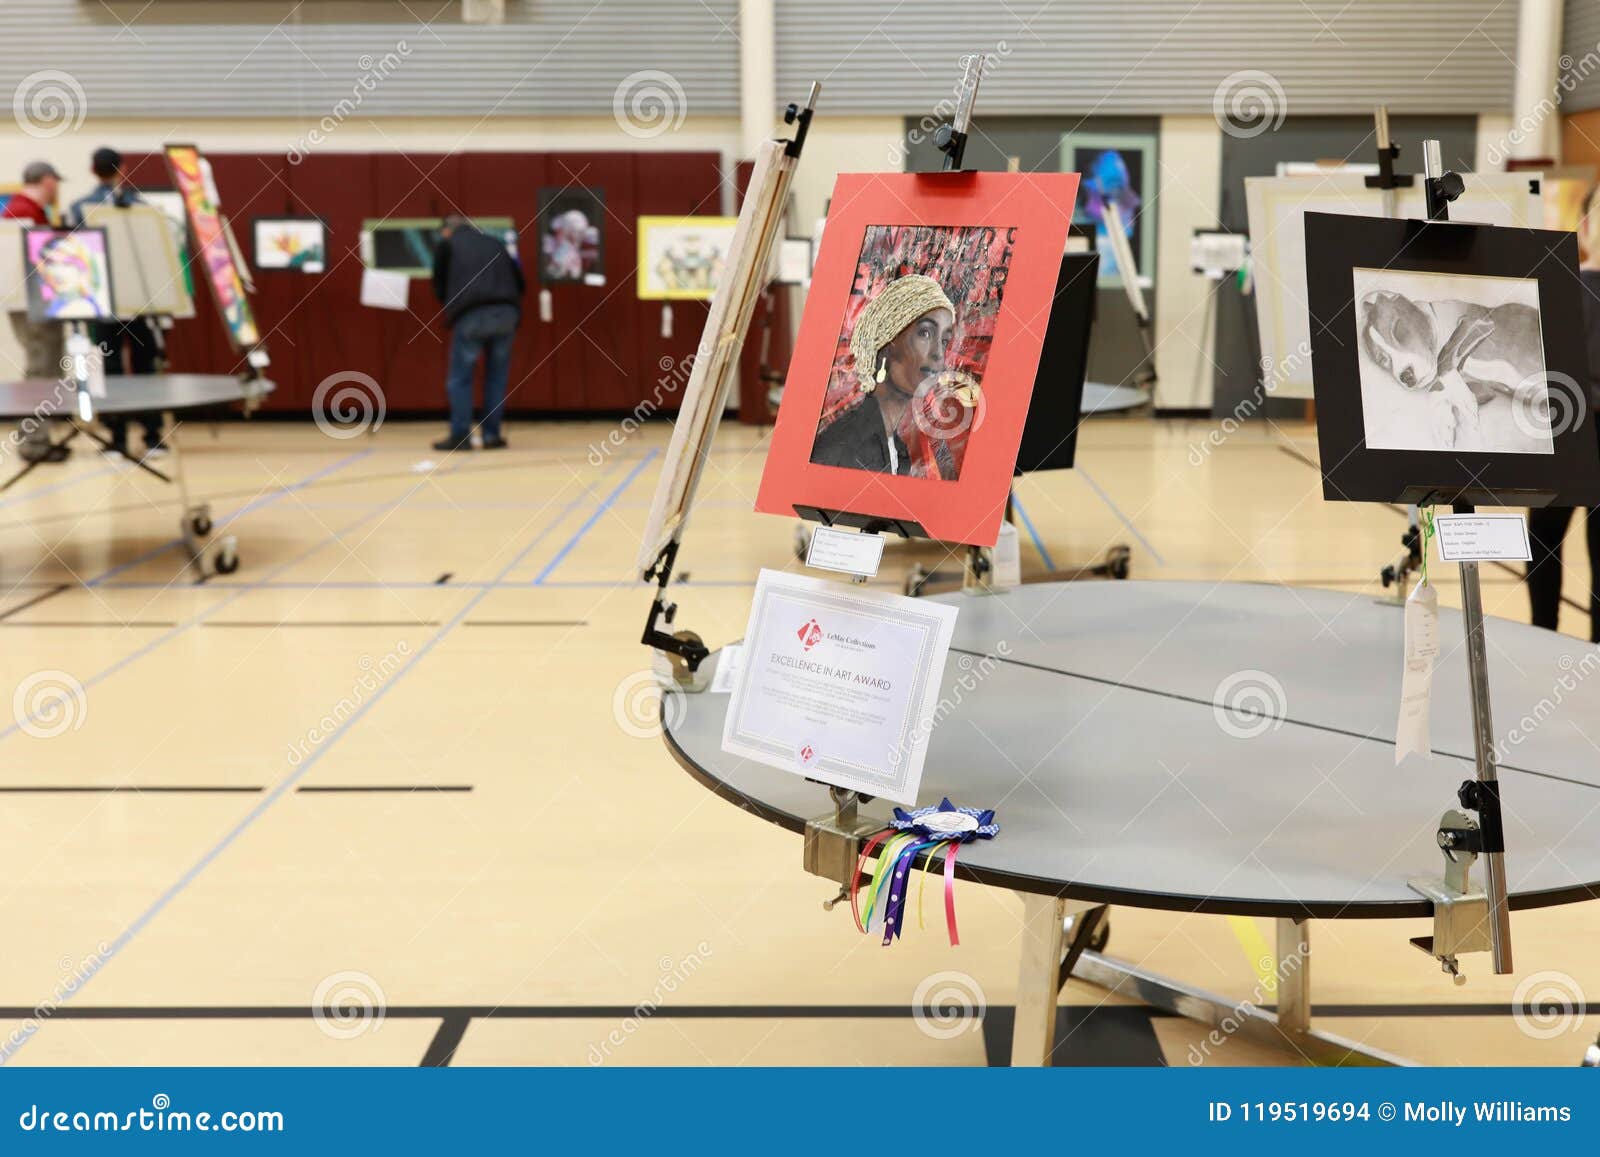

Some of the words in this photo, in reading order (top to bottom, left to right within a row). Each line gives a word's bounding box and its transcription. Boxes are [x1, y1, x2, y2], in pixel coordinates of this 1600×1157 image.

[770, 653, 822, 675] EXCELLENCE
[823, 665, 834, 677] IN
[834, 669, 852, 682] ART
[853, 674, 892, 691] AWARD
